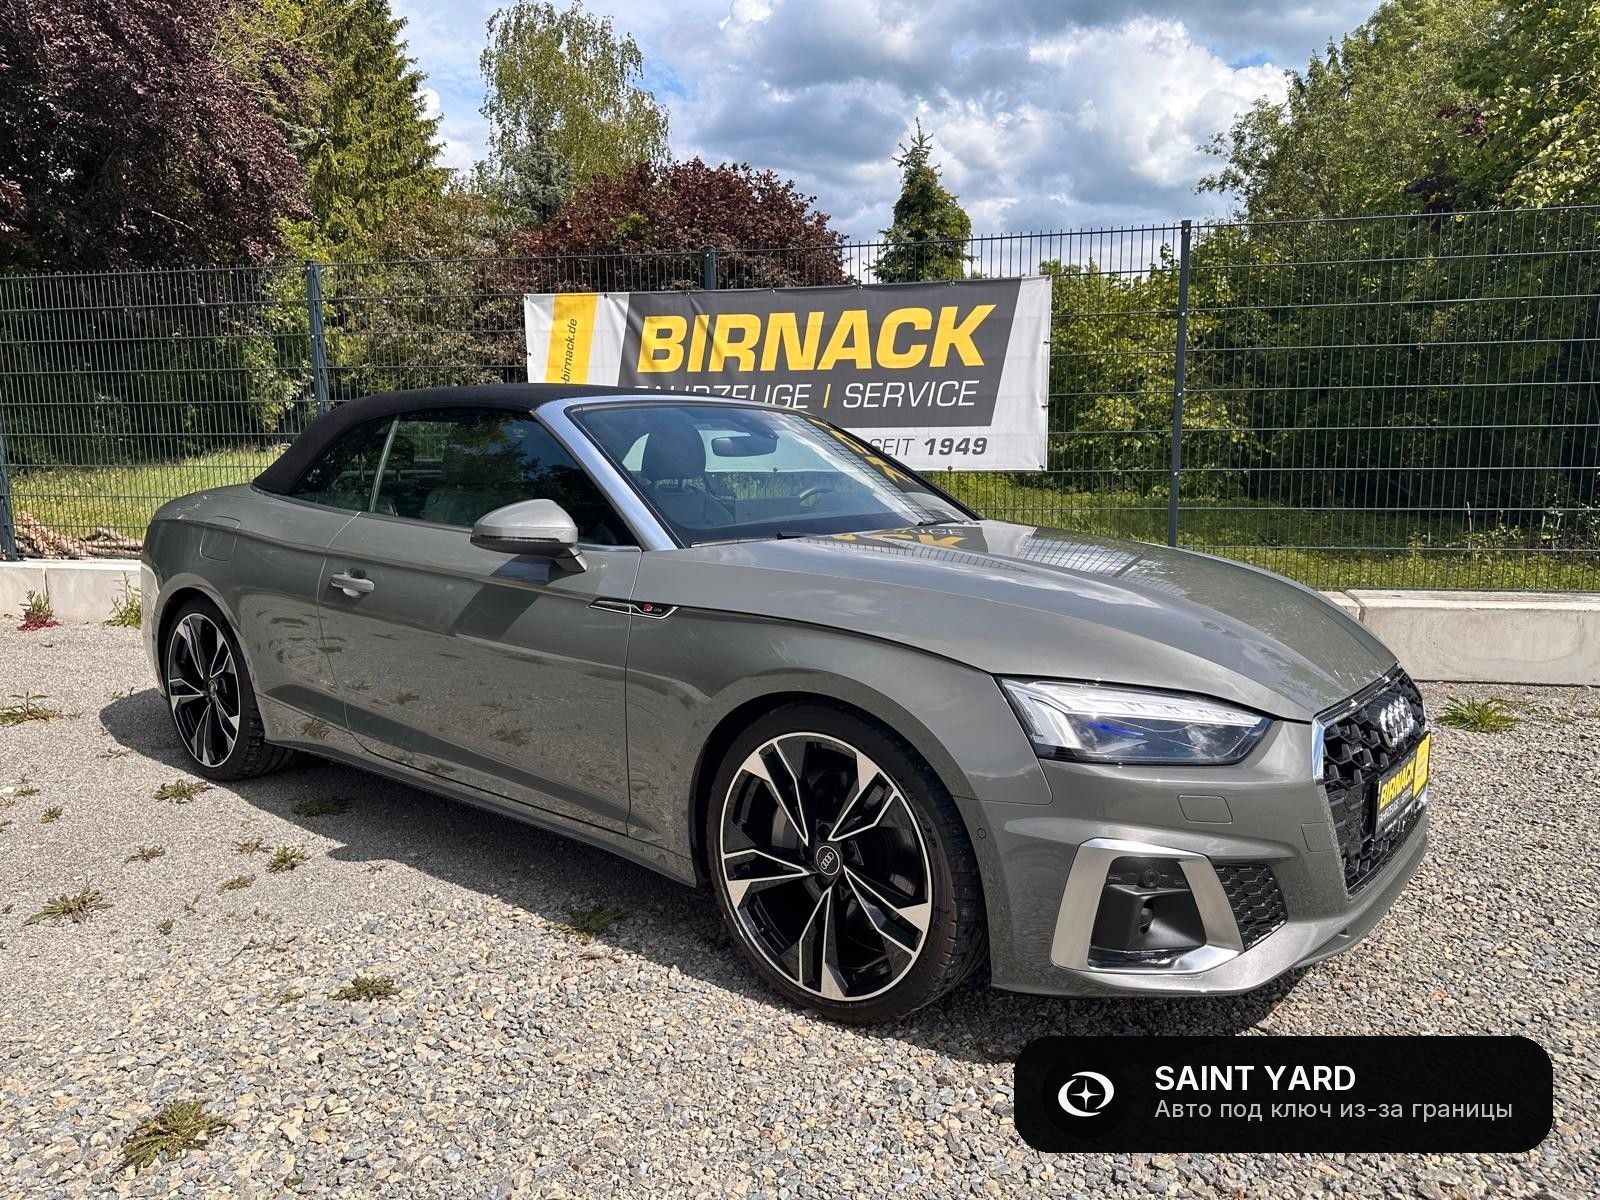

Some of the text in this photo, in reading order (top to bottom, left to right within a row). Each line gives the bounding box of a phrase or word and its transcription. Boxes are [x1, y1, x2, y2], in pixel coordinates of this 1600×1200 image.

[638, 304, 996, 373] BIRNACK
[634, 384, 812, 409] ZEUGE
[842, 380, 980, 409] SERVICE
[869, 437, 988, 456] SEIT 1949
